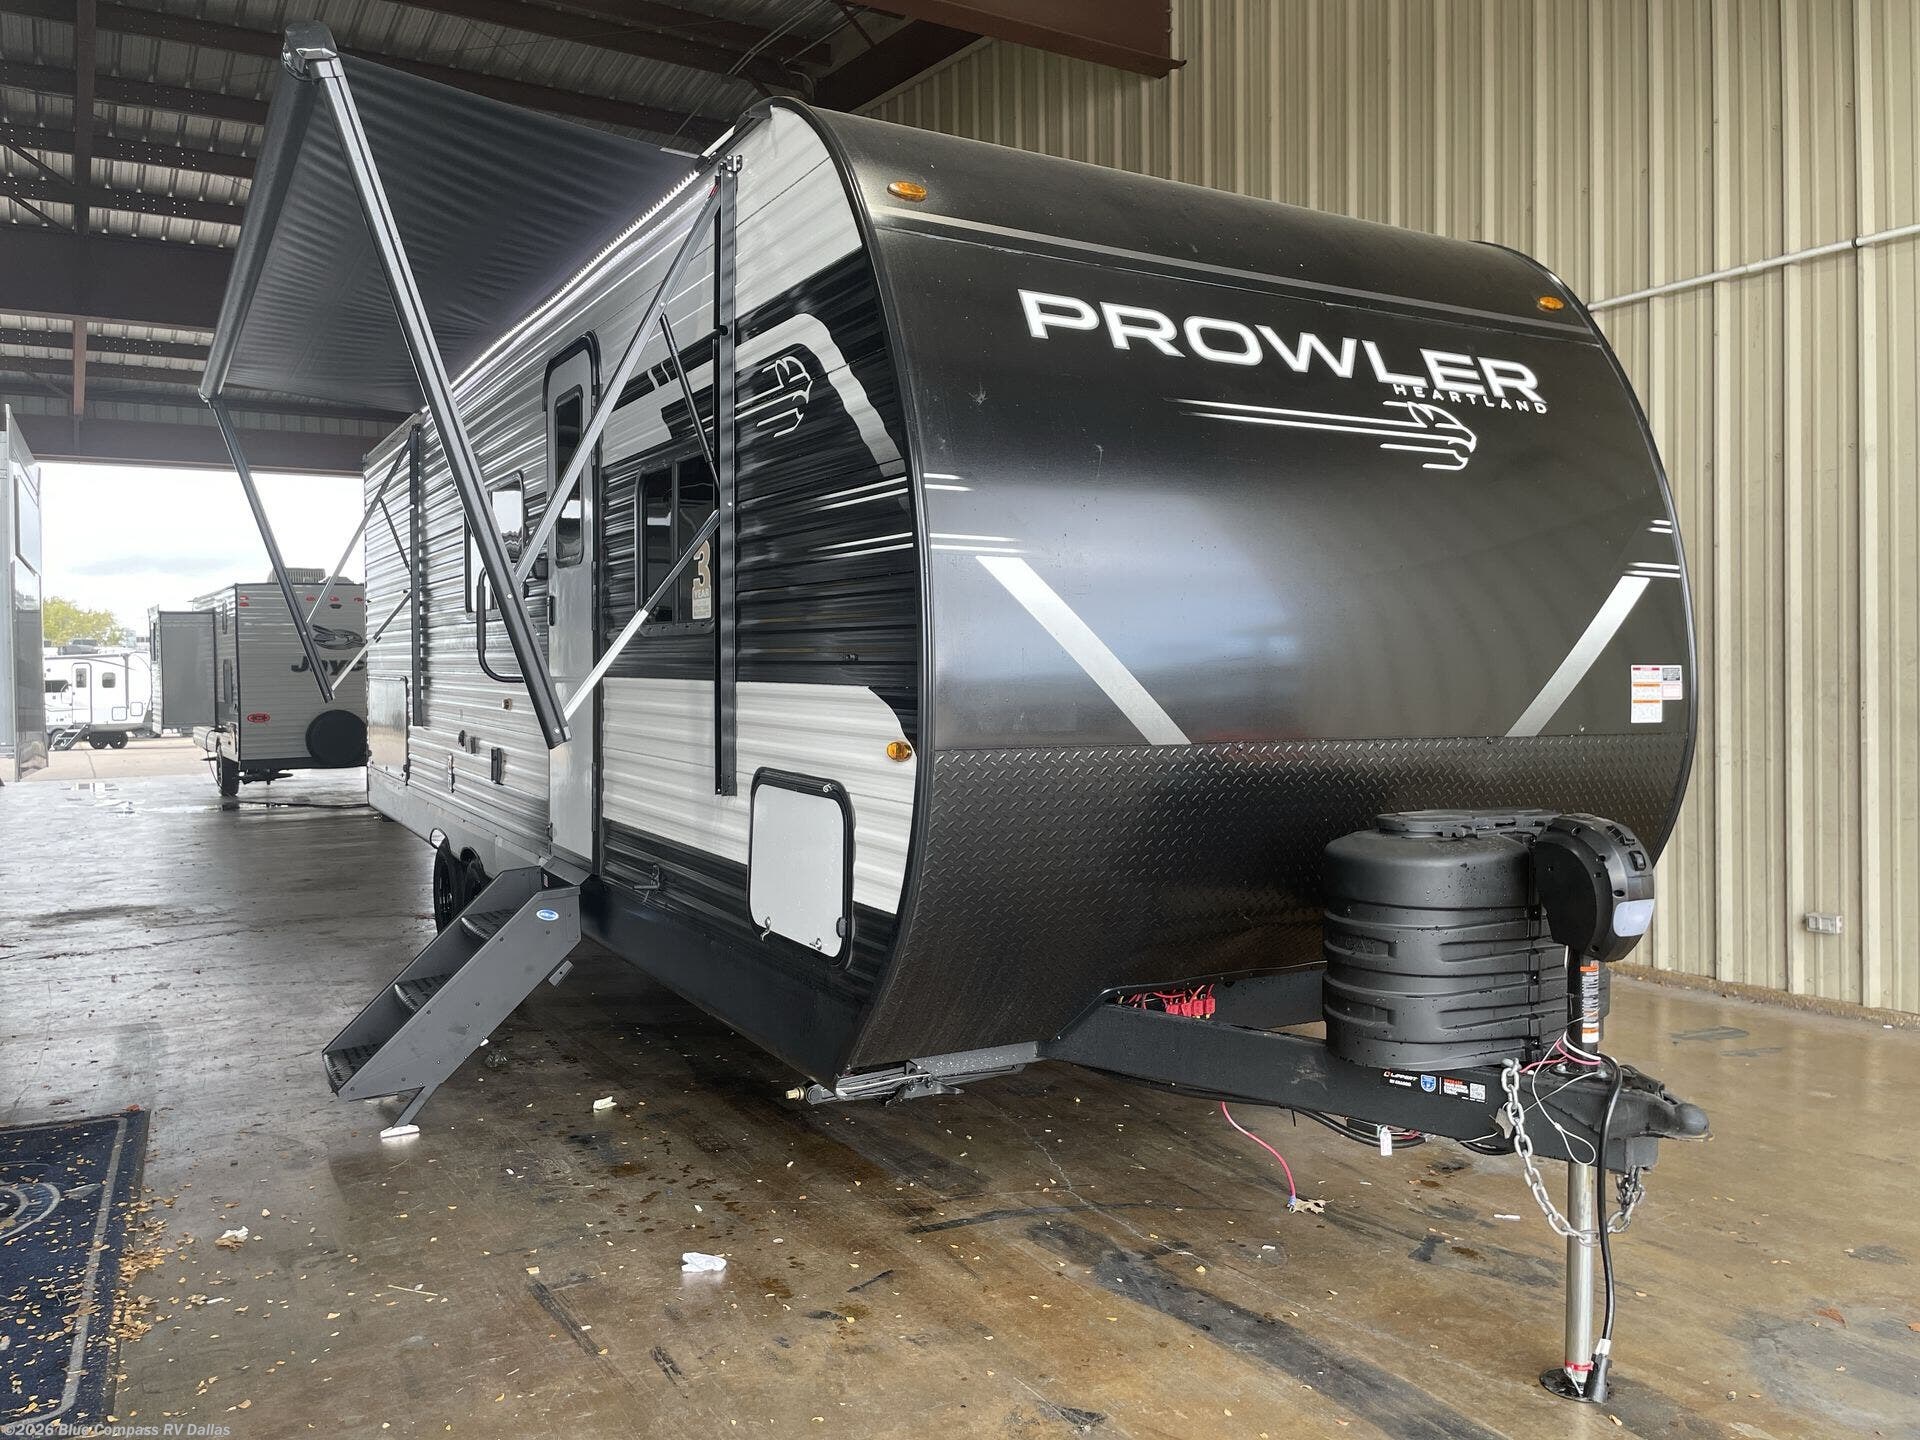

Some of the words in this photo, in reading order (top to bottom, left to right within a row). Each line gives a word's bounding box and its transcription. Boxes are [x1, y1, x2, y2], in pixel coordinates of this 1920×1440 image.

[1018, 289, 1547, 404] PROWLER
[1393, 383, 1548, 414] HEARTLAND
[693, 540, 710, 588] 3
